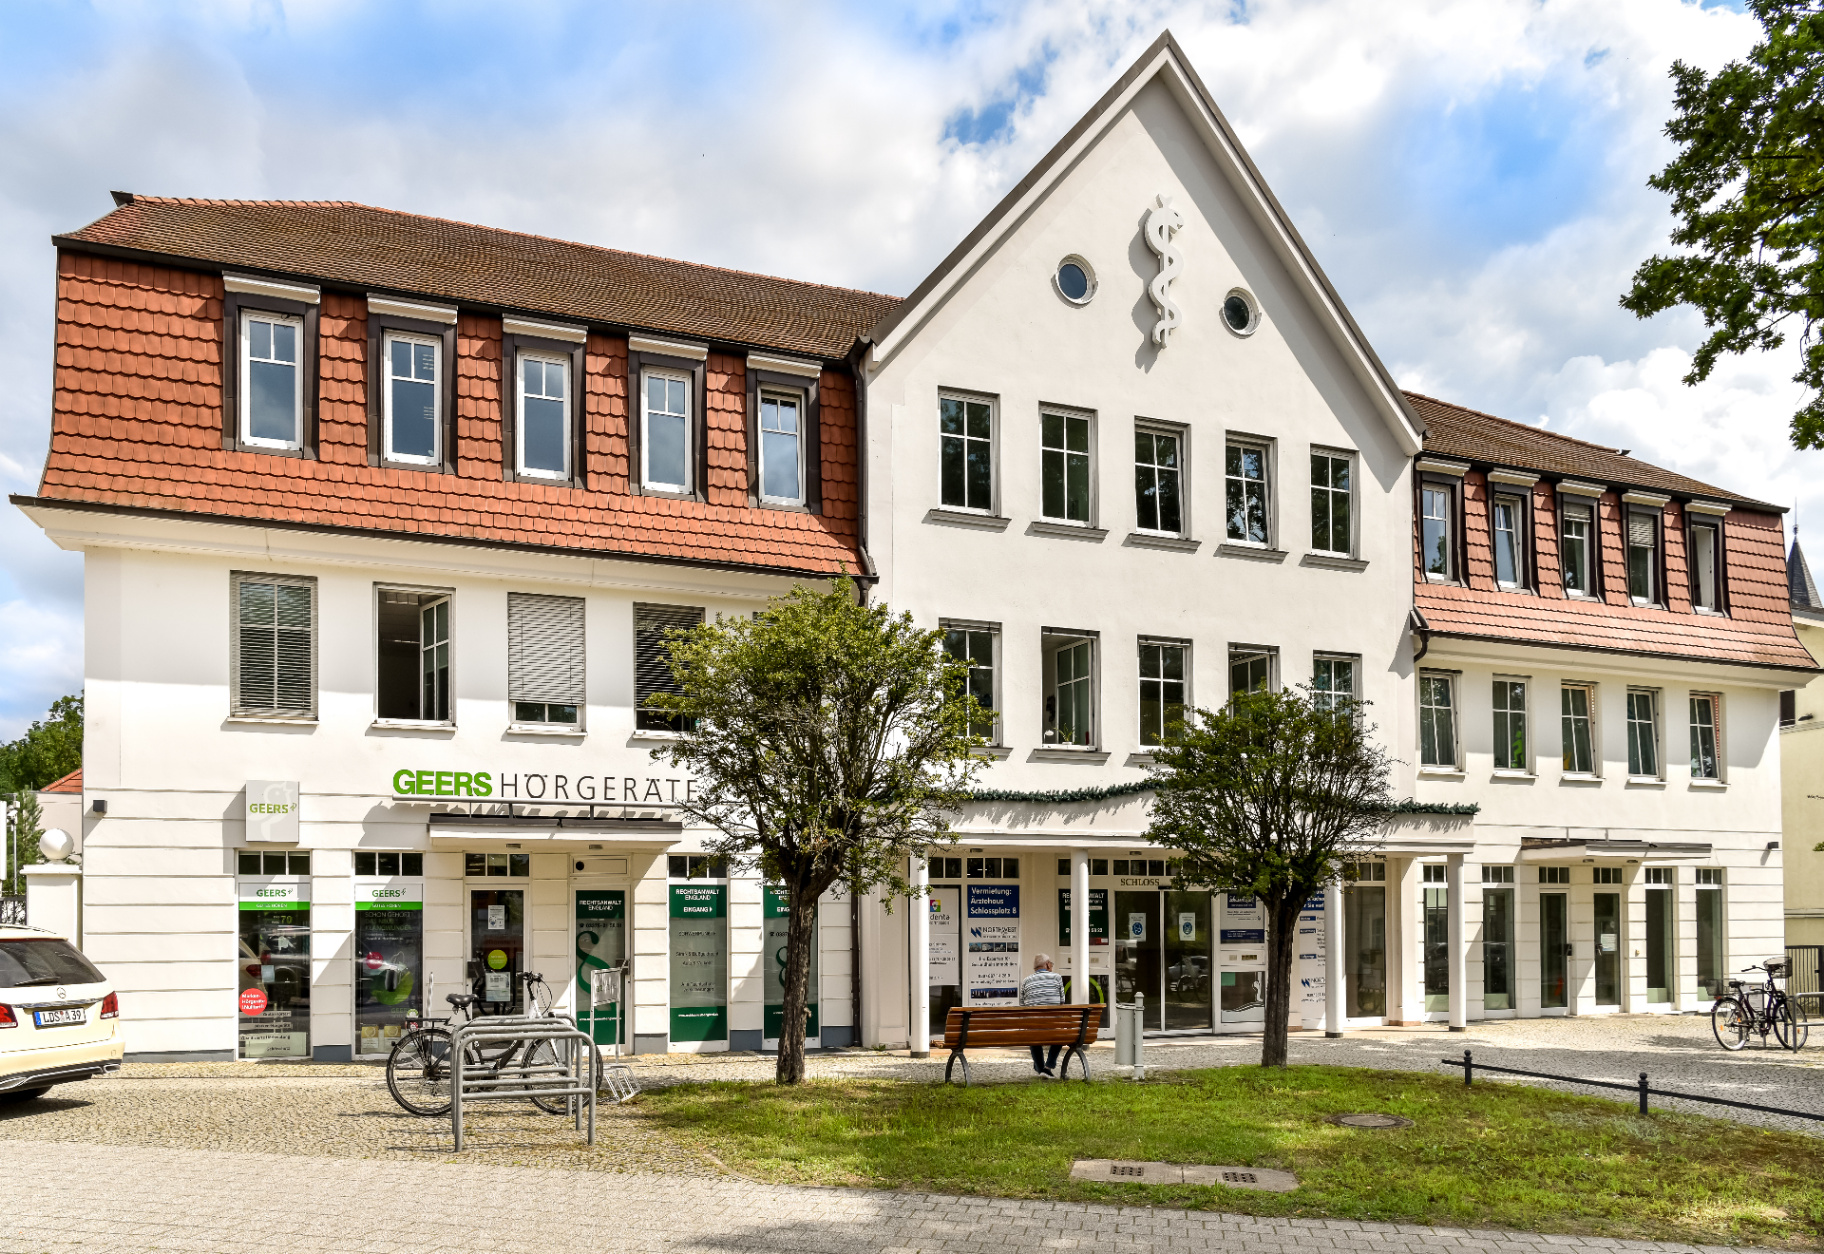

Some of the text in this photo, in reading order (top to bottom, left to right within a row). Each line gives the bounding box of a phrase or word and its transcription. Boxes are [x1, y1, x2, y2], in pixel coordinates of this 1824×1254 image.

[393, 769, 698, 803] GEERS HÖRGERÄTE
[249, 803, 288, 814] GEERS
[1120, 878, 1160, 886] SCHLOSS
[256, 889, 287, 897] GEERS
[372, 889, 401, 897] GEERS
[971, 886, 1012, 896] Vermietung:
[971, 896, 1004, 905] Ärztehaus
[971, 906, 1017, 915] Schlossplatz 8
[43, 1010, 82, 1023] LDS A 39
